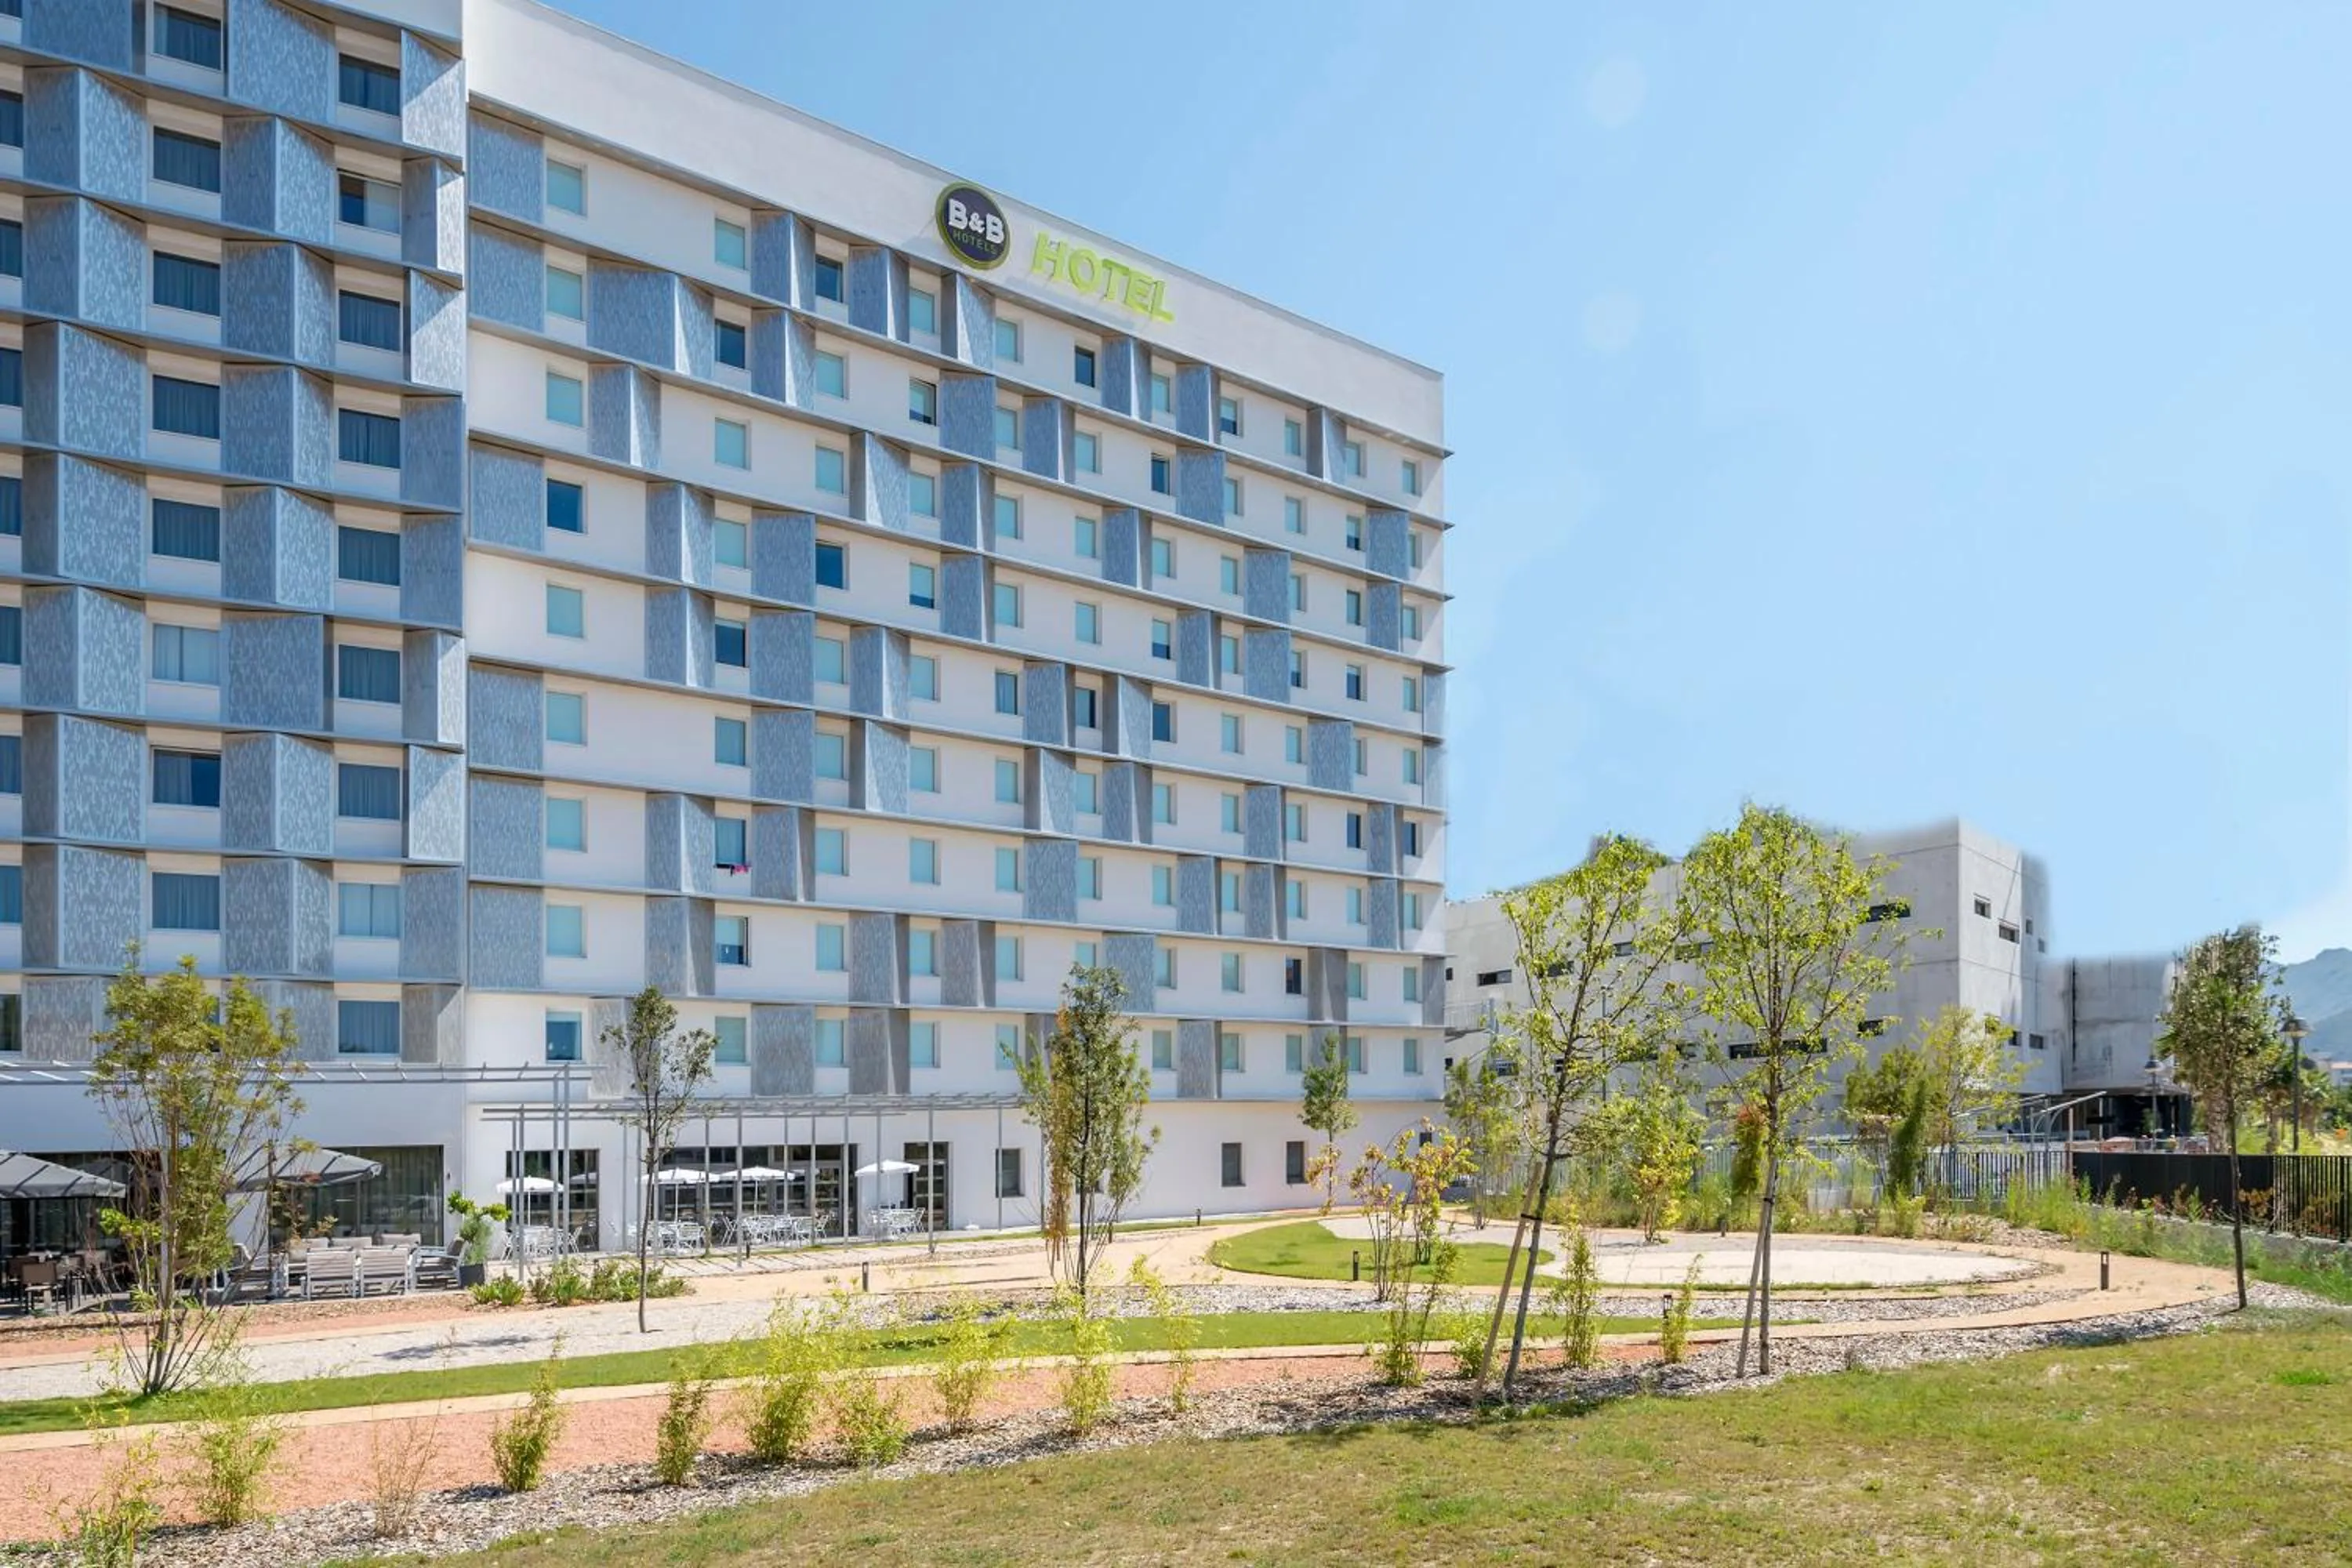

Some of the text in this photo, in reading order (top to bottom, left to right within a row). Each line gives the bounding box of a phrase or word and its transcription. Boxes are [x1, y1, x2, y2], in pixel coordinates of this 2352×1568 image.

[948, 199, 1004, 244] B&B
[952, 229, 998, 256] HOTELS
[1032, 232, 1173, 321] HOTEL
